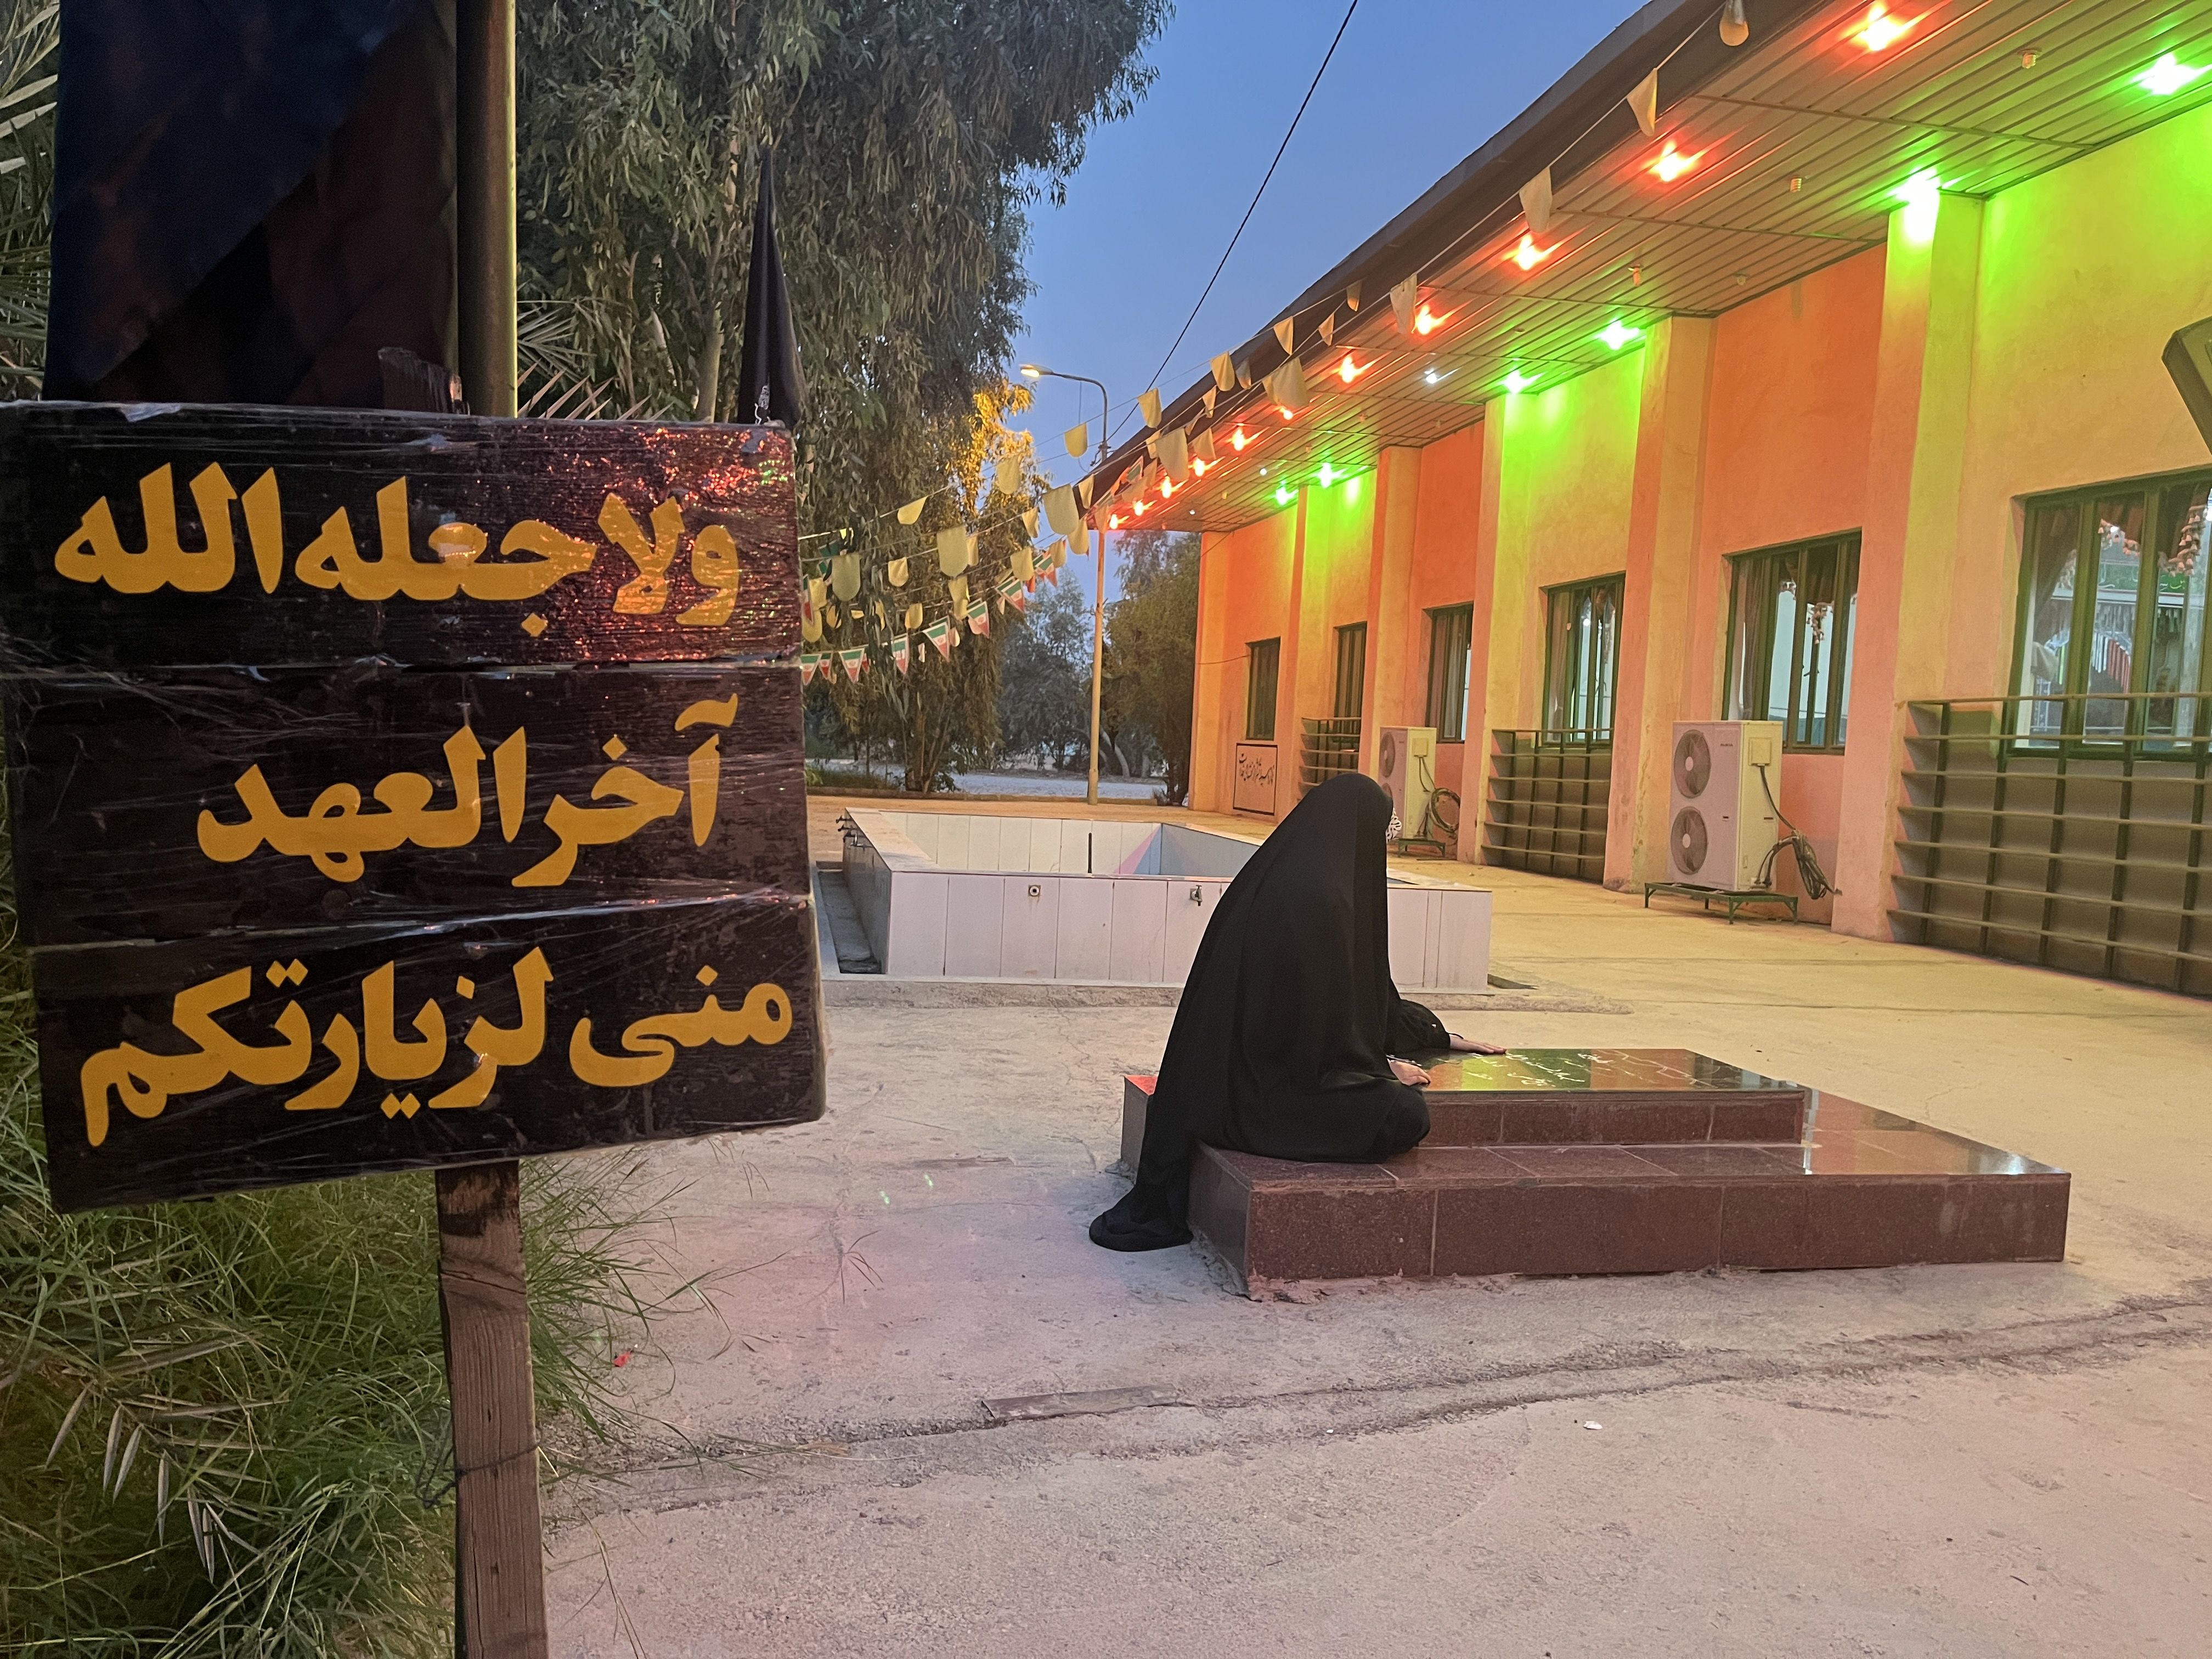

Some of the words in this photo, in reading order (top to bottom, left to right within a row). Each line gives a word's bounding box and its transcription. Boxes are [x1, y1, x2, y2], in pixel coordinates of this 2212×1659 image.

[54, 462, 283, 594] الله
[295, 476, 599, 637] جعله
[597, 493, 741, 627] ولا
[197, 725, 527, 883] العهد
[512, 694, 738, 888] آخر
